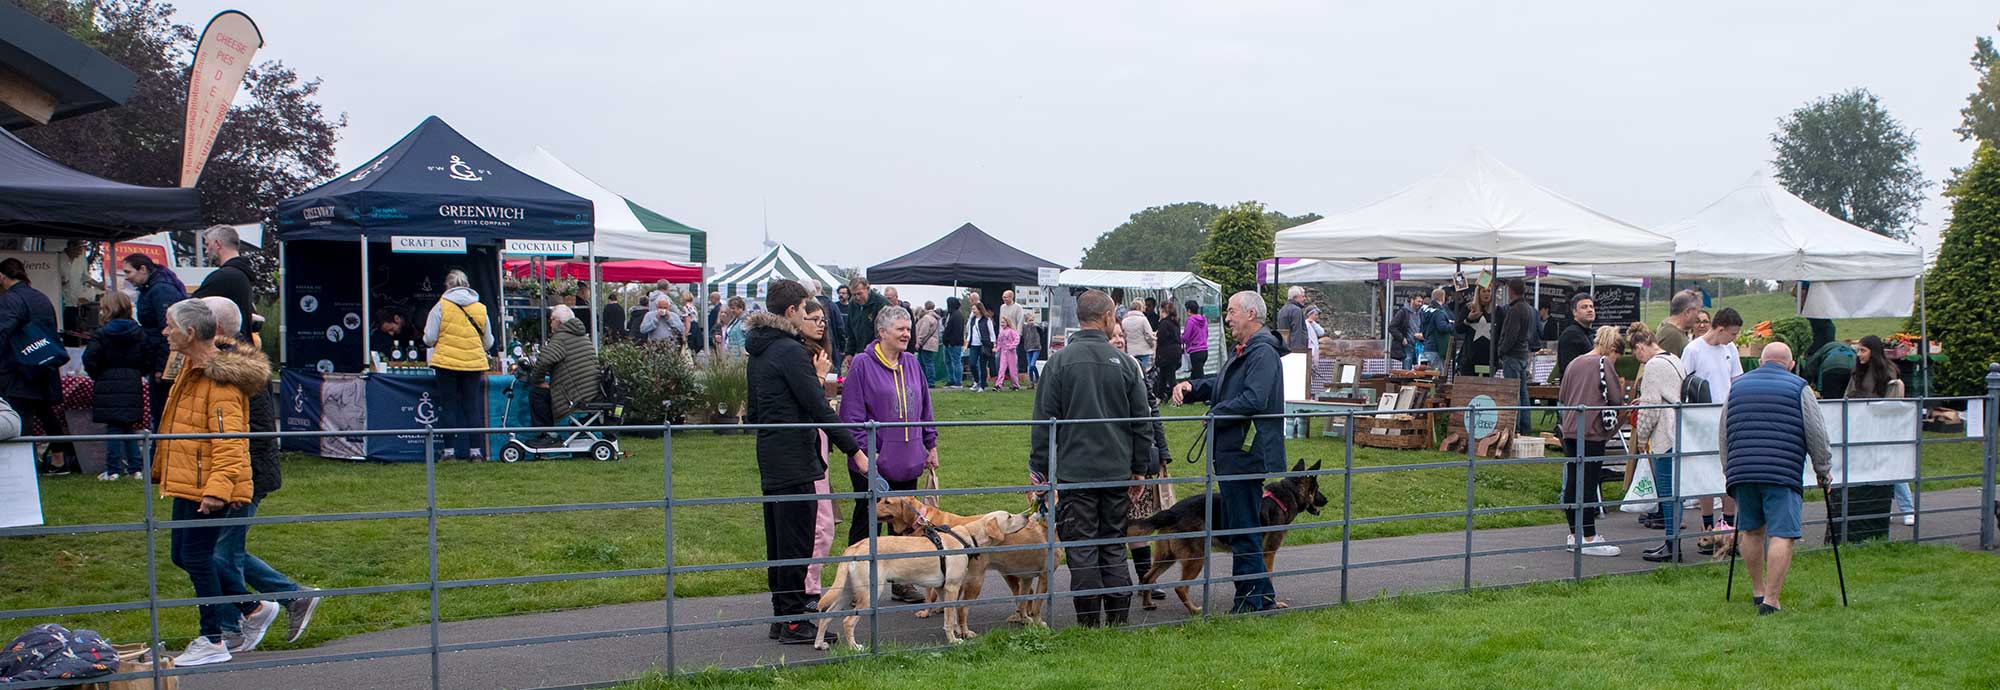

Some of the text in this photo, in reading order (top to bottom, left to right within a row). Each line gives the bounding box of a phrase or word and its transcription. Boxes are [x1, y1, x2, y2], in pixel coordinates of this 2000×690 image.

[216, 32, 248, 55] CHEESE
[216, 50, 235, 66] PIES
[439, 205, 525, 219] GREENWICH
[400, 238, 461, 248] CRAFT GIN
[511, 242, 568, 252] COCKTAILS
[21, 338, 51, 356] TRUNK
